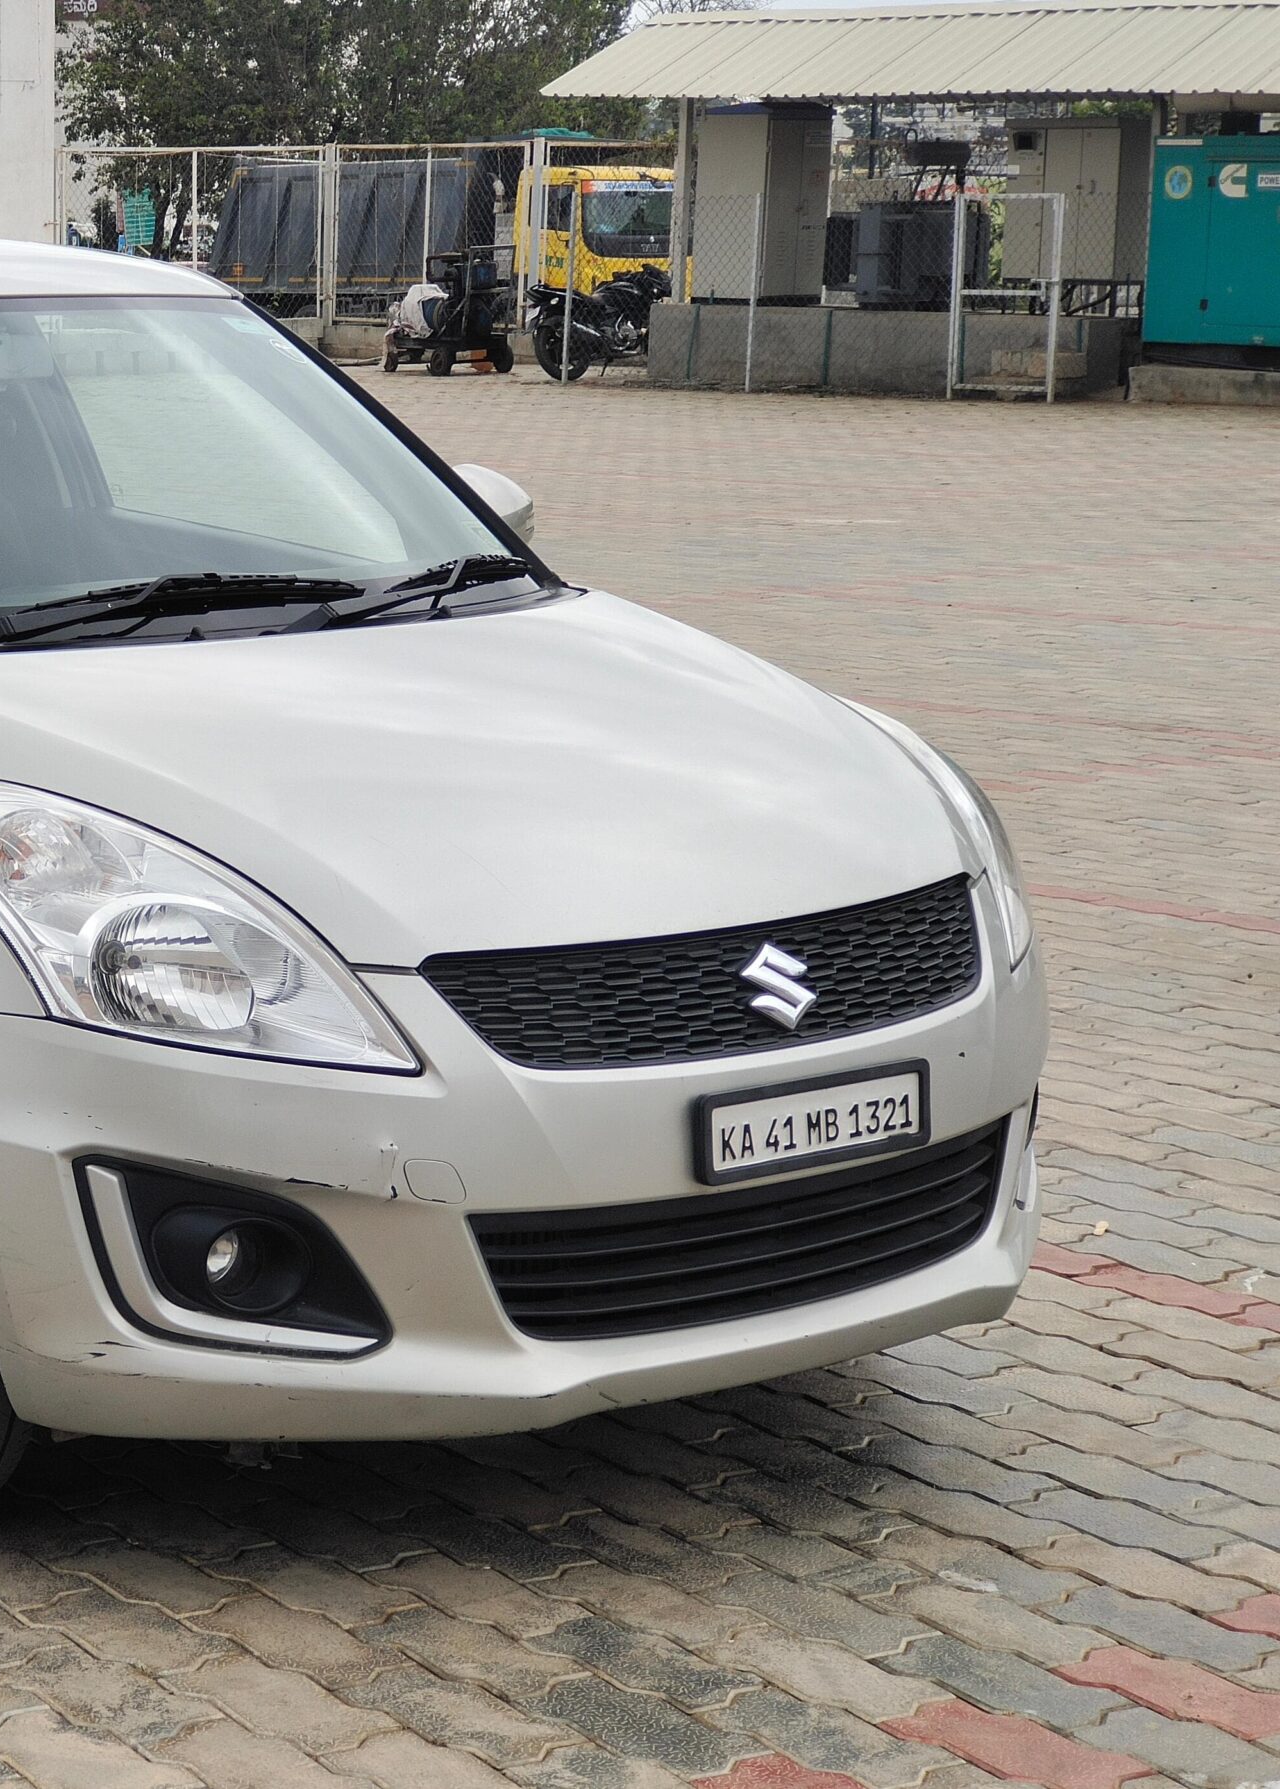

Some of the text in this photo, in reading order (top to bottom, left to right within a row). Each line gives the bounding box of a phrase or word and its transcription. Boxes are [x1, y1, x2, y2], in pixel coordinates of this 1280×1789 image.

[721, 1093, 913, 1162] KA 41 MB 1321
